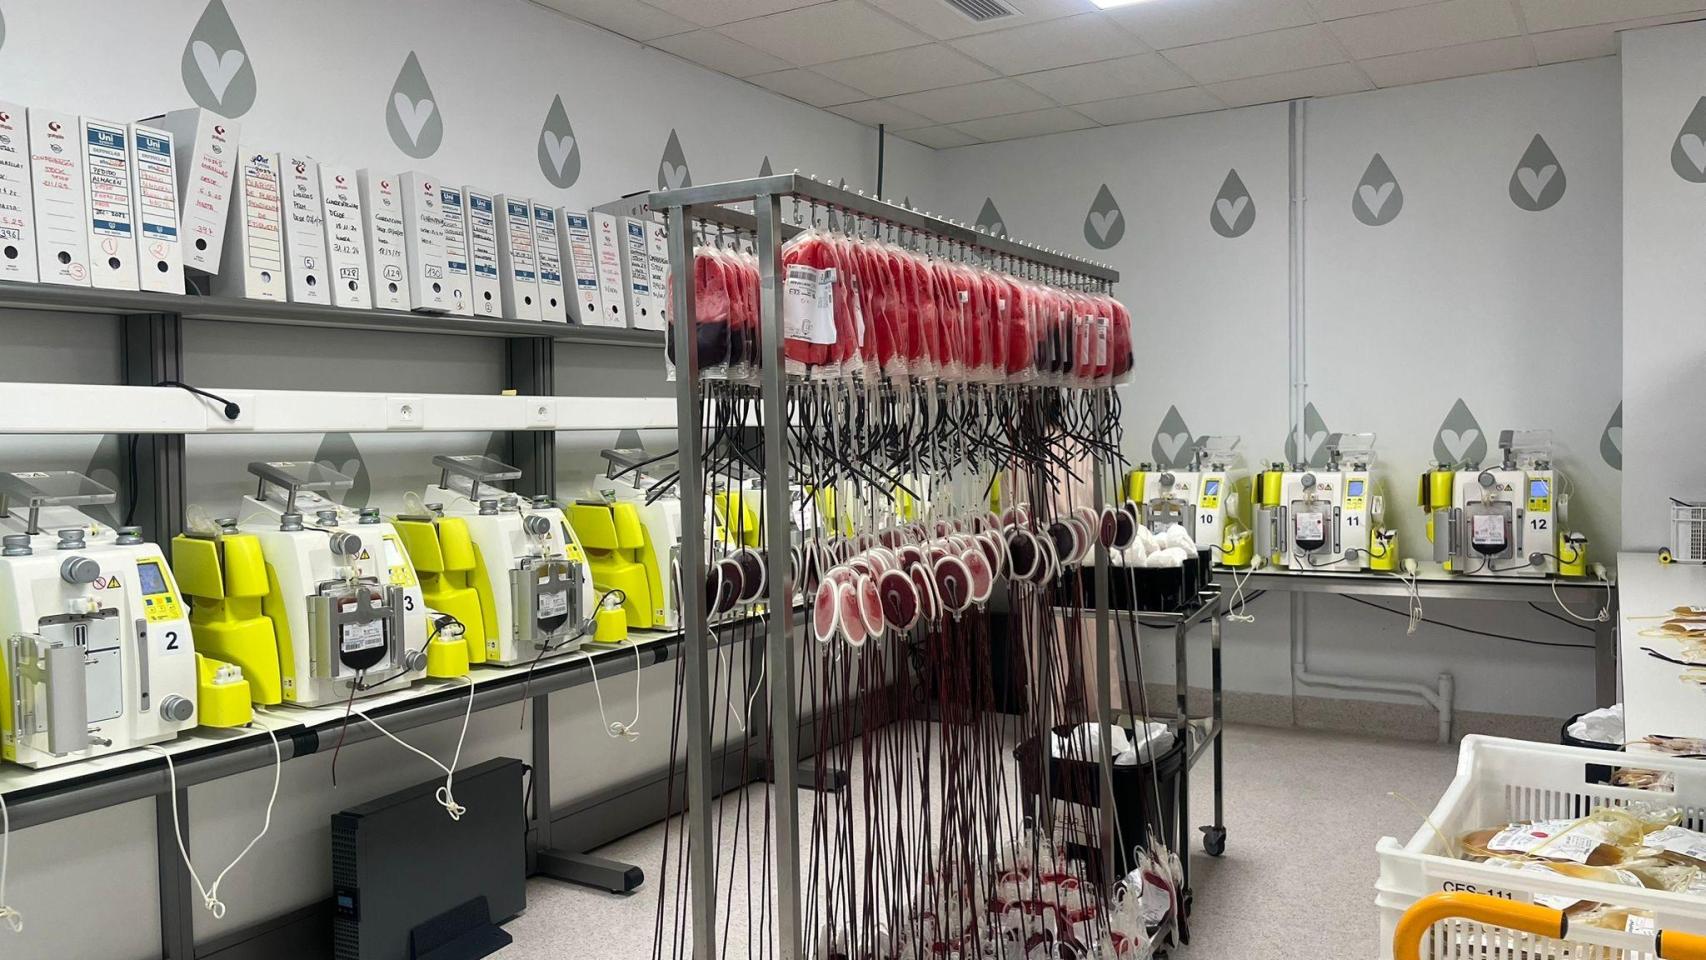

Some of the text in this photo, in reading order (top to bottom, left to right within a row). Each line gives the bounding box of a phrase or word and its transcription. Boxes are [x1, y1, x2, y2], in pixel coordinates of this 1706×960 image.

[98, 132, 114, 143] Uni
[146, 138, 161, 150] Uni
[1200, 514, 1213, 524] 10
[1346, 516, 1359, 526] 11
[1530, 519, 1547, 530] 12
[403, 595, 414, 611] 3
[165, 631, 179, 651] 2
